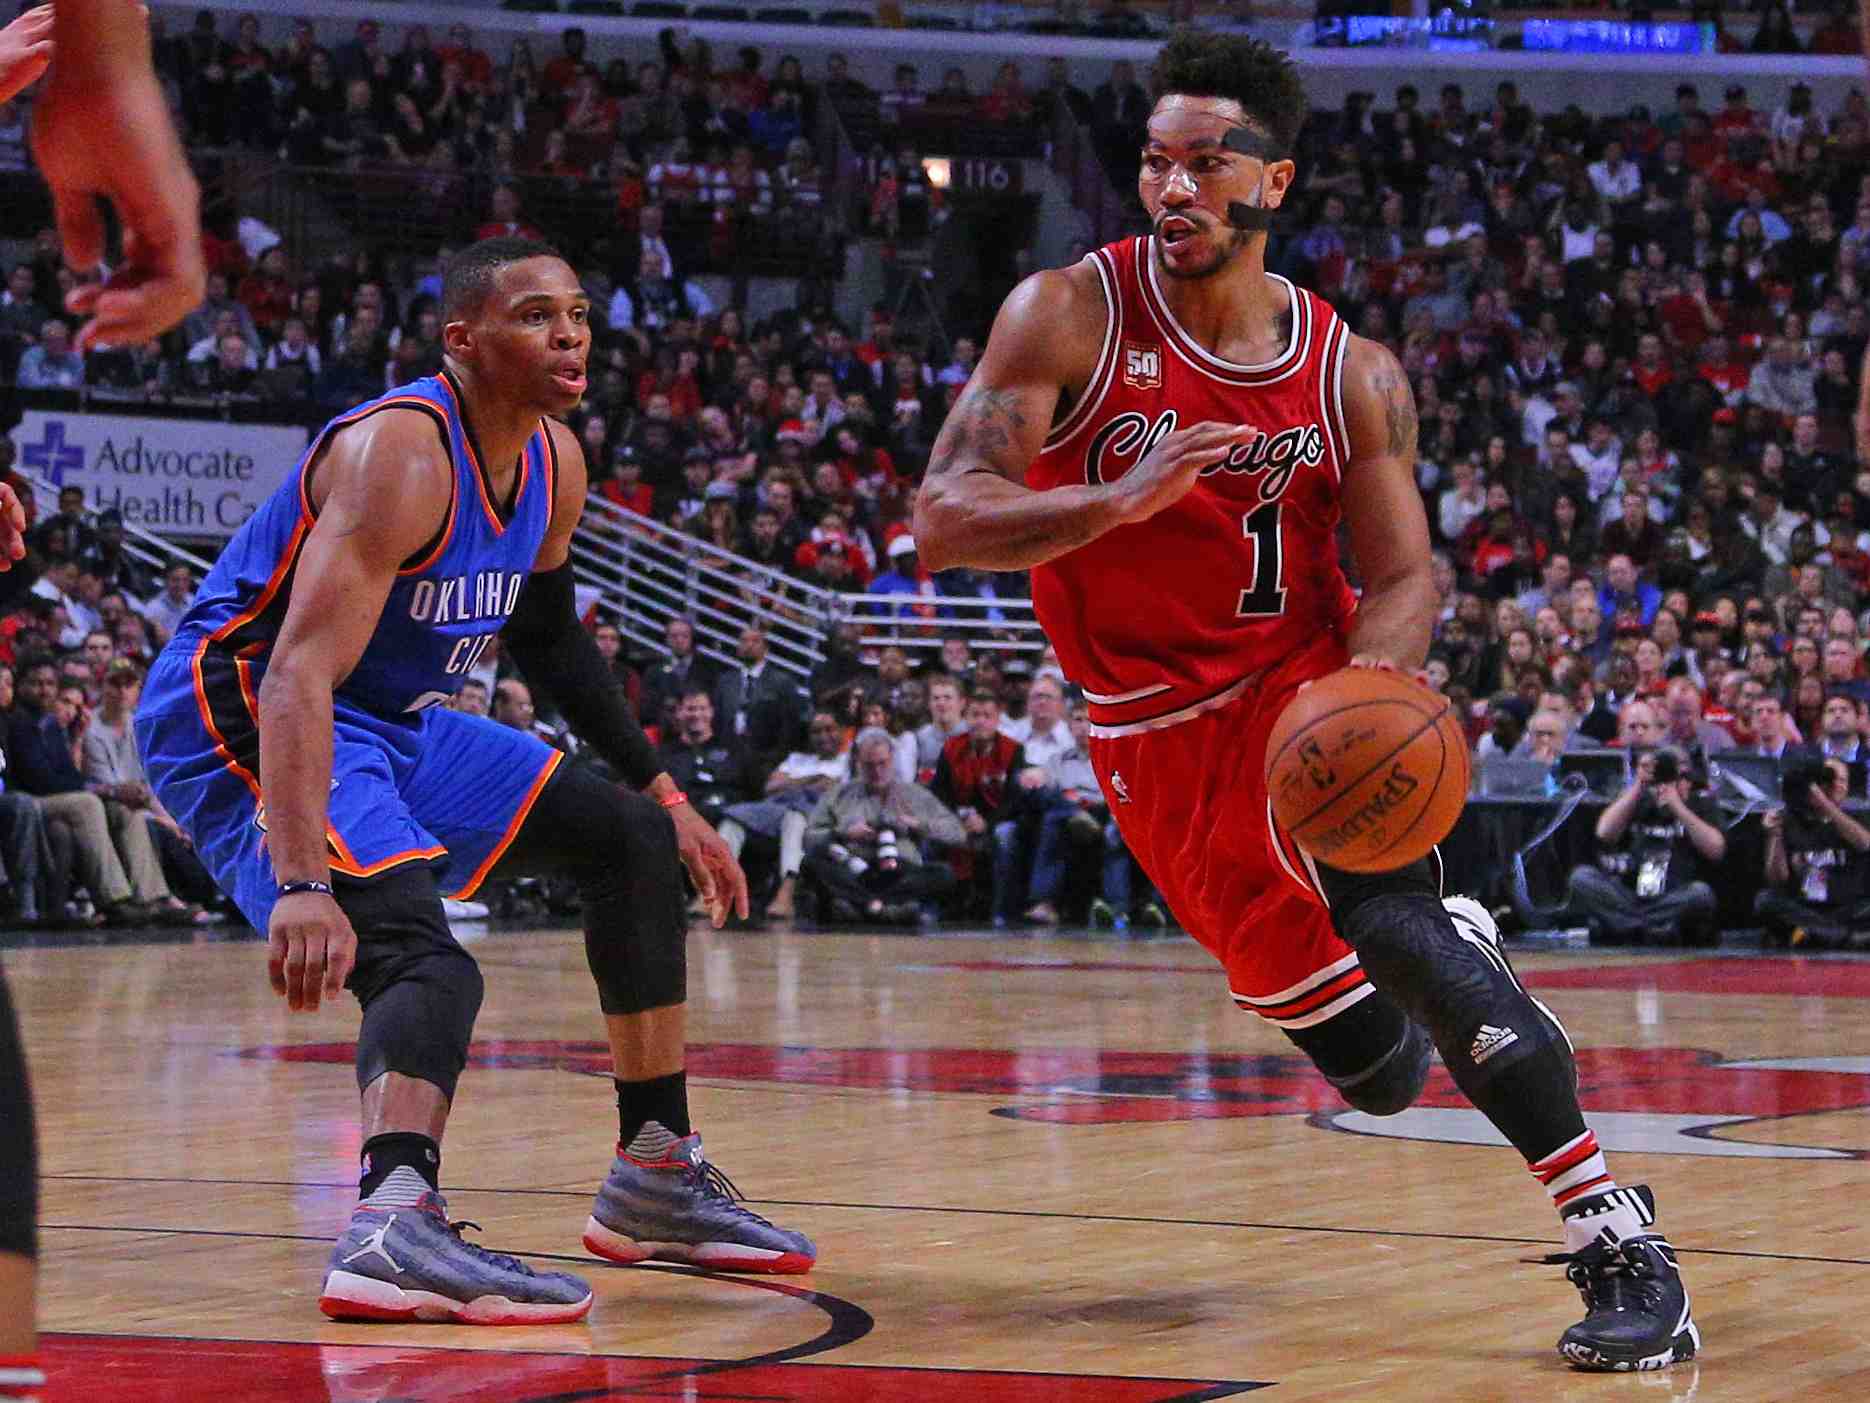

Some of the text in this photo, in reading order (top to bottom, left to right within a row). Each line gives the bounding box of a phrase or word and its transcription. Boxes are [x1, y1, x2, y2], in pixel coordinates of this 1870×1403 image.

[1127, 350, 1158, 378] 50
[94, 436, 255, 481] Advocate
[95, 485, 205, 526] Health
[1235, 502, 1289, 617] 1
